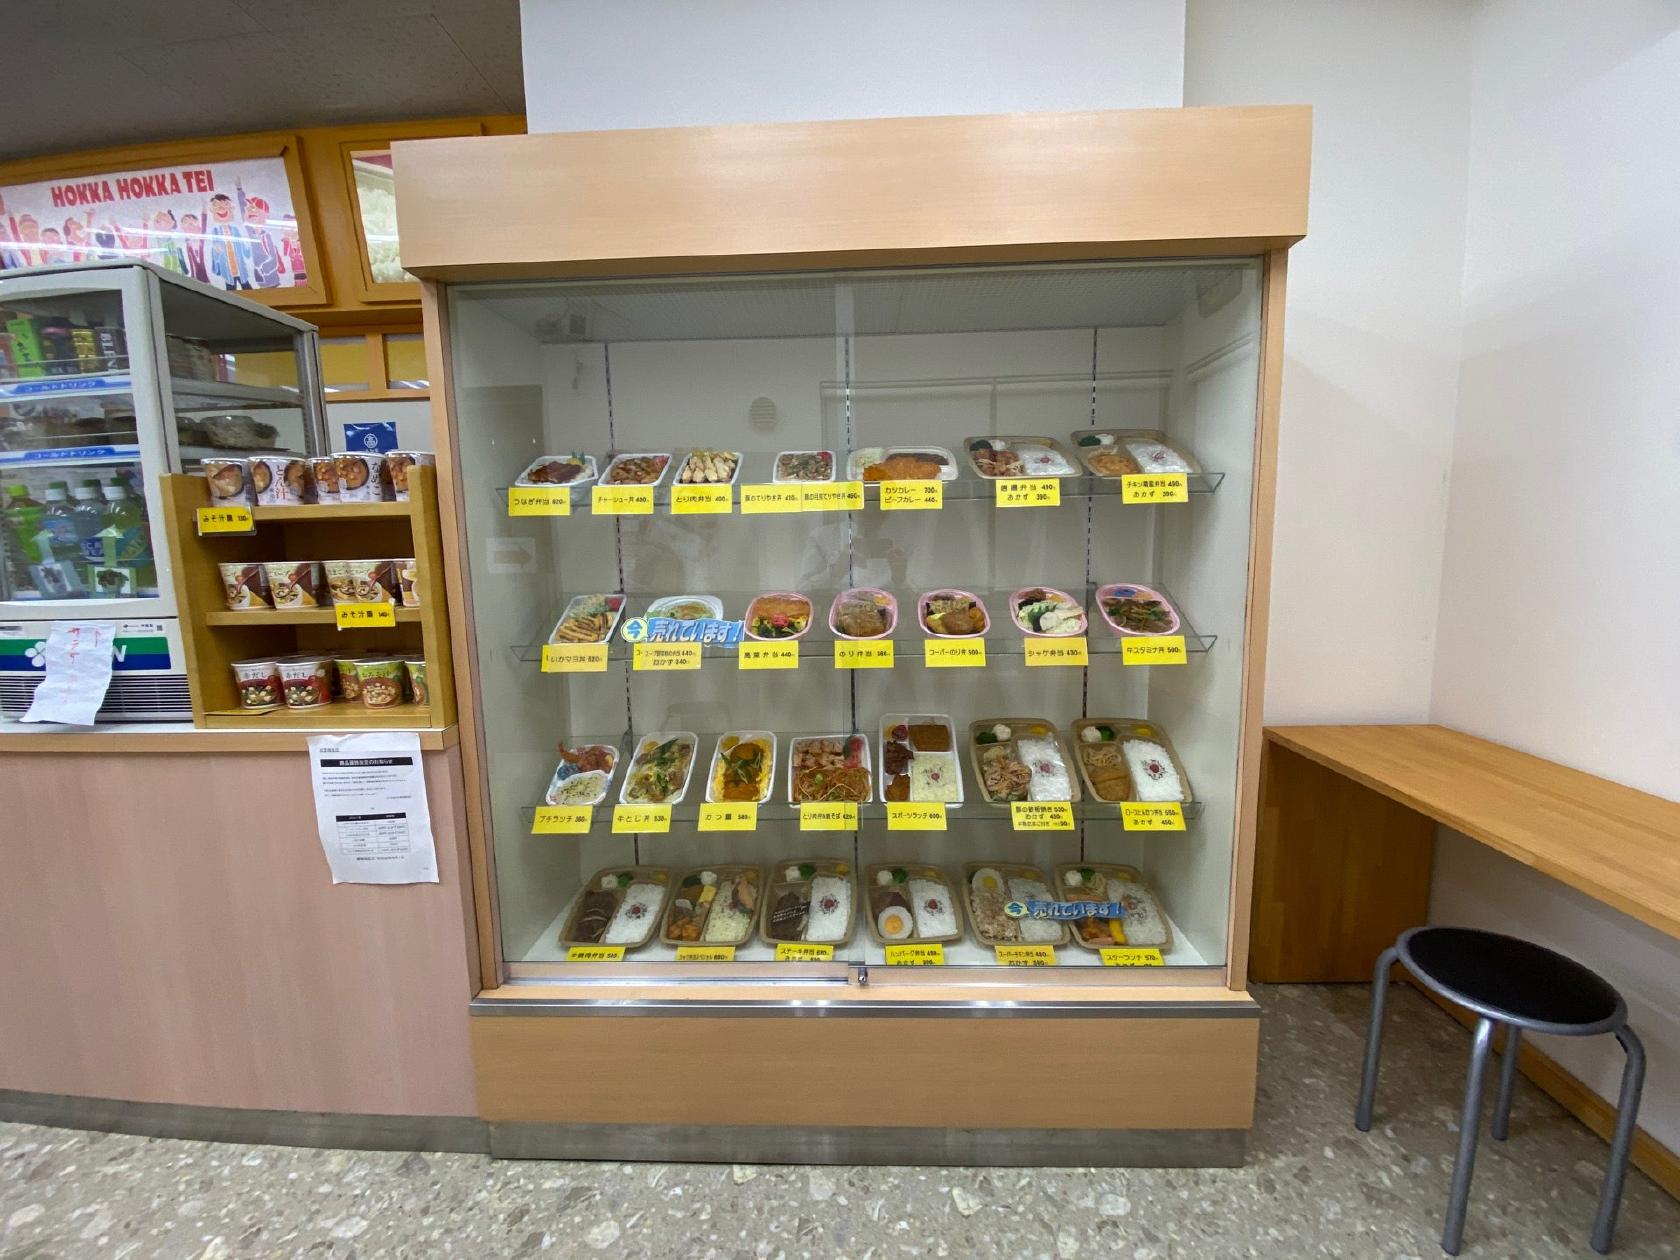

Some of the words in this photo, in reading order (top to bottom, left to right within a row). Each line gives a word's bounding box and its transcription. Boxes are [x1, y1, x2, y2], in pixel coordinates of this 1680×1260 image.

[51, 180, 115, 208] HOKKA
[116, 172, 181, 201] HOKKA
[182, 169, 215, 193] TEI
[625, 620, 644, 639] 今
[1008, 902, 1023, 914] 今
